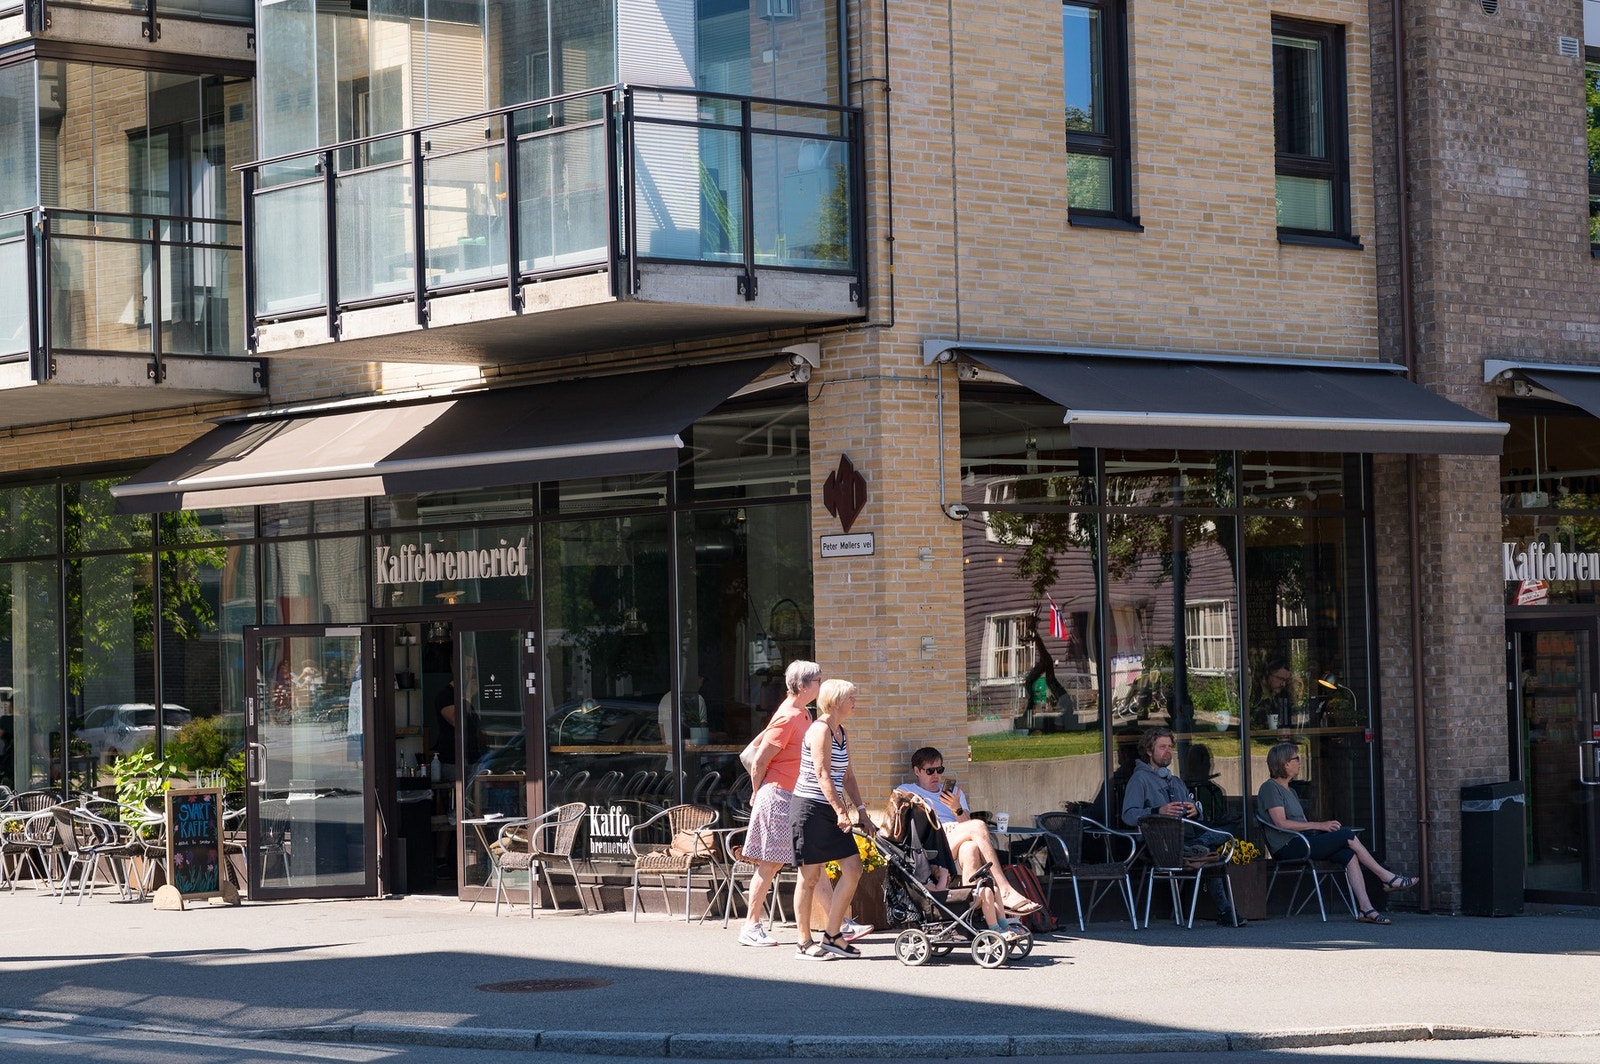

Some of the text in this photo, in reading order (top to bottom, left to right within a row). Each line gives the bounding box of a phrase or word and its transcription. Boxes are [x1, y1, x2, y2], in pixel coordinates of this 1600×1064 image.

[822, 540, 872, 551] Peter Møllers vei
[376, 537, 528, 585] Kaffebrenneriet
[1502, 541, 1600, 581] Kaffebren
[178, 803, 211, 822] SVART
[589, 805, 630, 837] Kaffe
[180, 821, 209, 838] KAFFE
[590, 838, 630, 854] brenneriet
